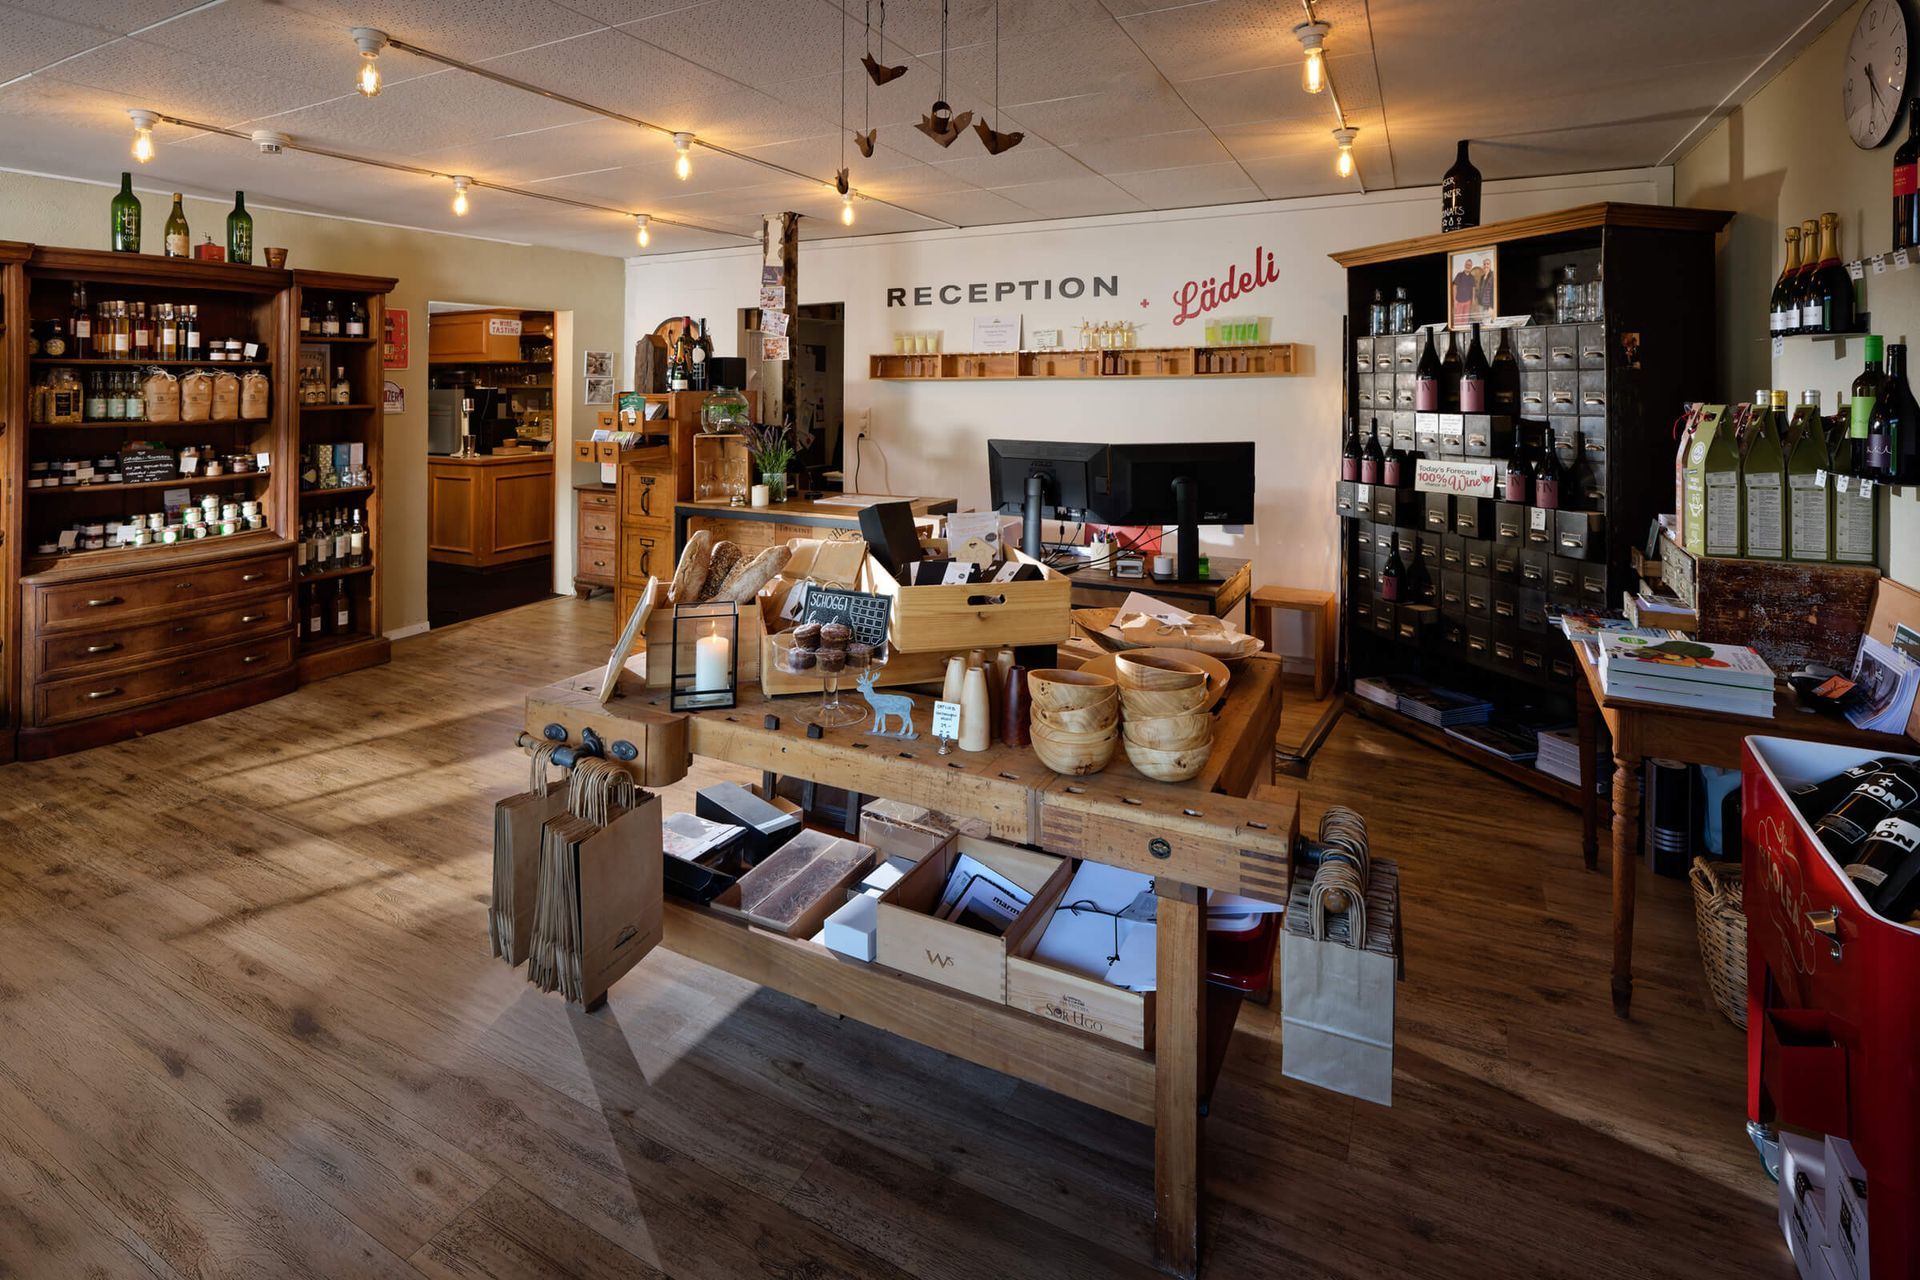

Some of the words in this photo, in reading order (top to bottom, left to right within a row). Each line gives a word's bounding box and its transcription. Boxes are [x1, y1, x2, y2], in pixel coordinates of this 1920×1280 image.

[1869, 10, 1877, 31] 12
[1894, 46, 1902, 66] 3
[1848, 78, 1854, 97] 9
[886, 275, 1118, 307] RECEPTION
[1172, 245, 1280, 326] Lädeli
[1419, 465, 1445, 473] Today's
[1446, 467, 1478, 475] Forecast
[1418, 472, 1448, 483] 100%
[1448, 475, 1482, 491] Wine
[810, 593, 849, 611] SCHOGGI
[1045, 1002, 1069, 1022] SOR
[1073, 1011, 1103, 1032] UGO
